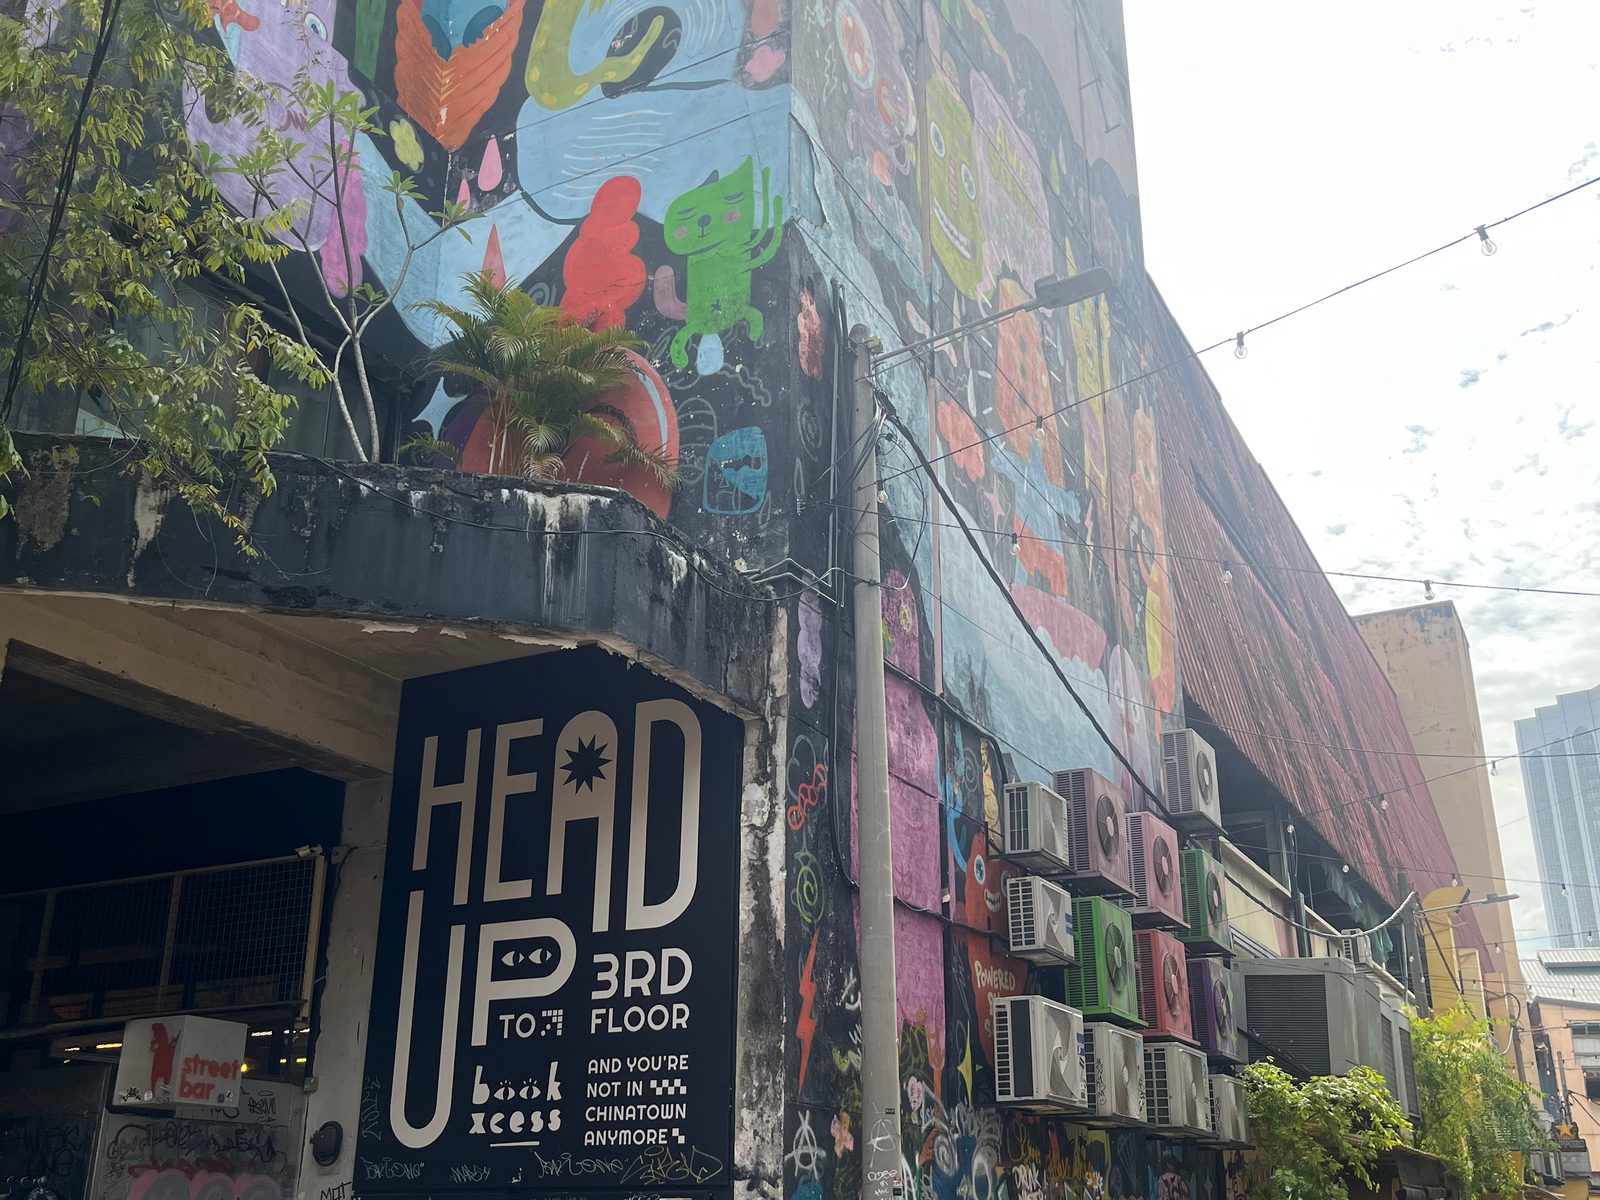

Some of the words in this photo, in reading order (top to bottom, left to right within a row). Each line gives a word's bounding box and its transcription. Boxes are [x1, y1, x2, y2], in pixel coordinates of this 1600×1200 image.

[412, 698, 702, 933] HEAD
[591, 947, 693, 1000] 3RD
[974, 960, 1016, 991] POWERED
[389, 890, 577, 1149] UP
[499, 1012, 536, 1038] TO
[590, 1003, 690, 1035] FLOOR
[184, 1054, 240, 1080] street
[588, 1058, 622, 1075] AND
[626, 1054, 689, 1073] YOU'RE
[179, 1071, 216, 1100] bar
[472, 1061, 562, 1105] book
[586, 1081, 621, 1098] NOT
[627, 1080, 643, 1097] IN
[468, 1109, 562, 1134] xcess
[585, 1103, 687, 1122] CHINATOWN
[584, 1128, 668, 1146] ANYMORE
